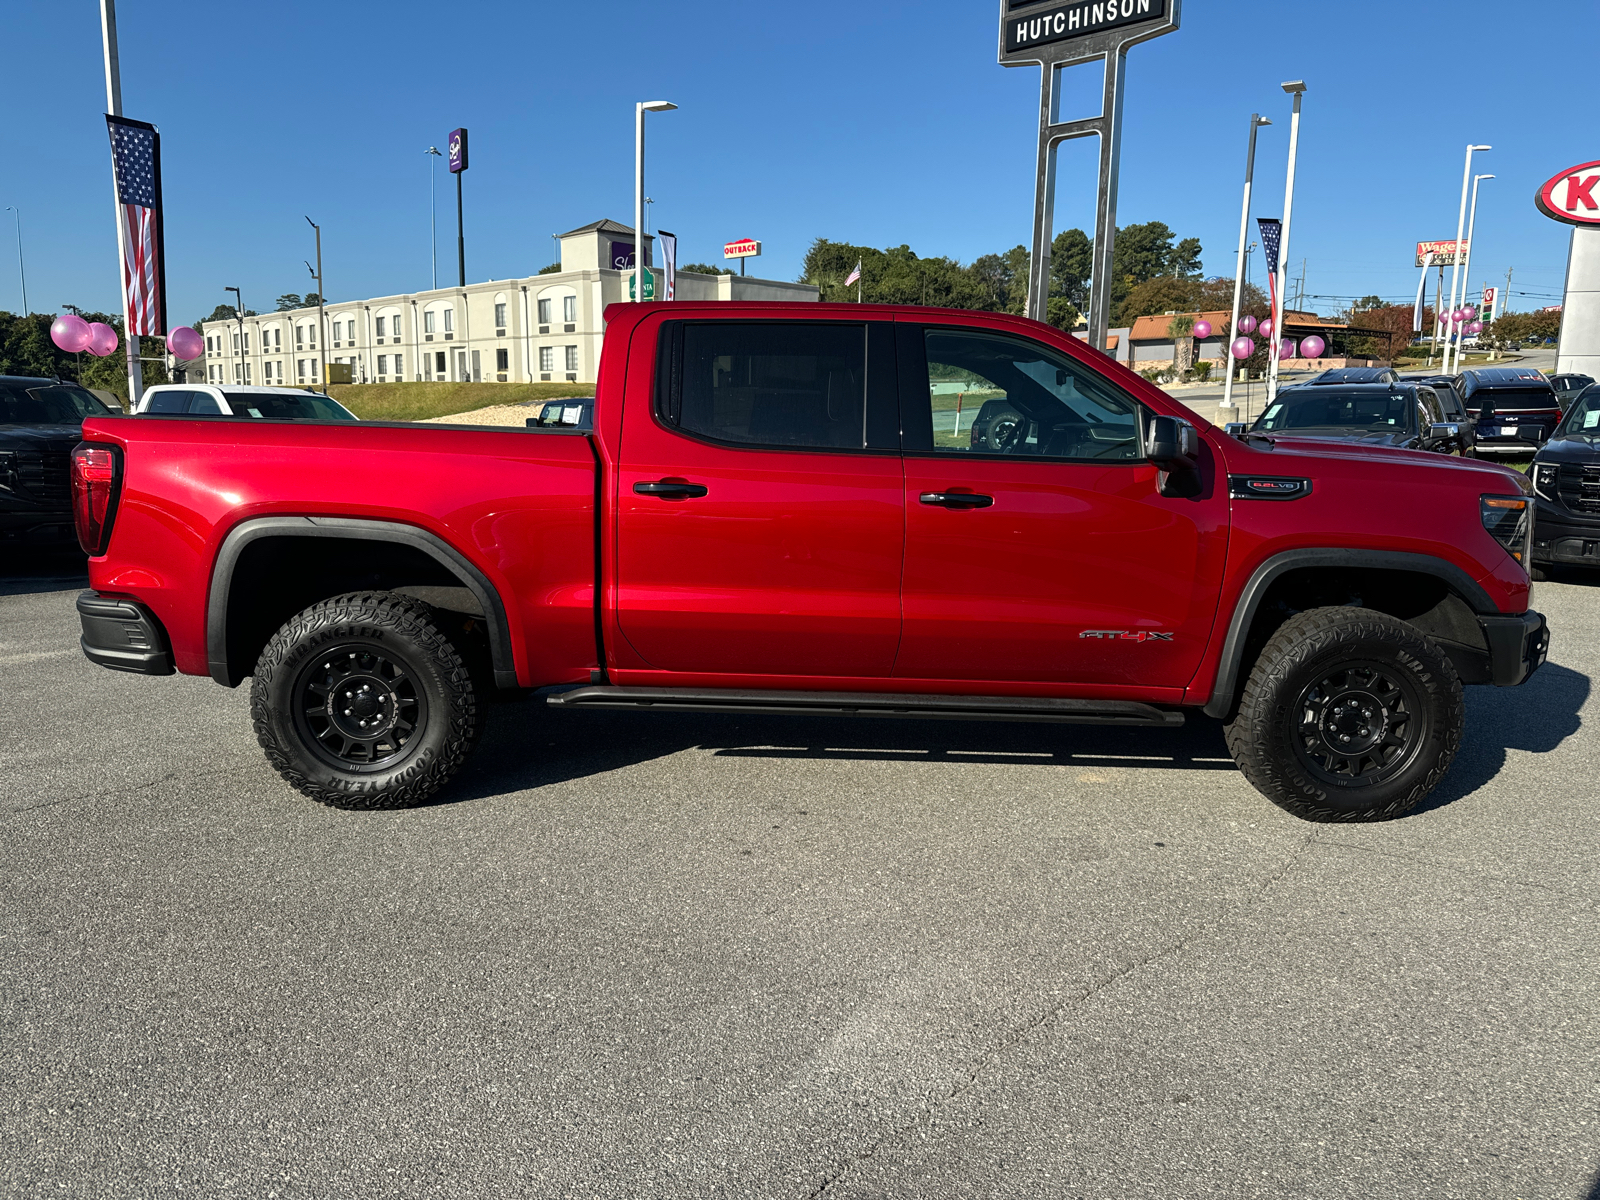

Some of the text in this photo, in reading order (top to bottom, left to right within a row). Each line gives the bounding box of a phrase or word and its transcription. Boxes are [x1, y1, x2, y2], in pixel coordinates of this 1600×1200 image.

[1017, 0, 1150, 43] HUTCHINSON
[724, 244, 756, 254] OUTBACK
[1420, 242, 1468, 254] Wages
[283, 626, 385, 670] WRANGLER
[1079, 629, 1174, 643] AT4X
[327, 746, 435, 793] GOODYEAR
